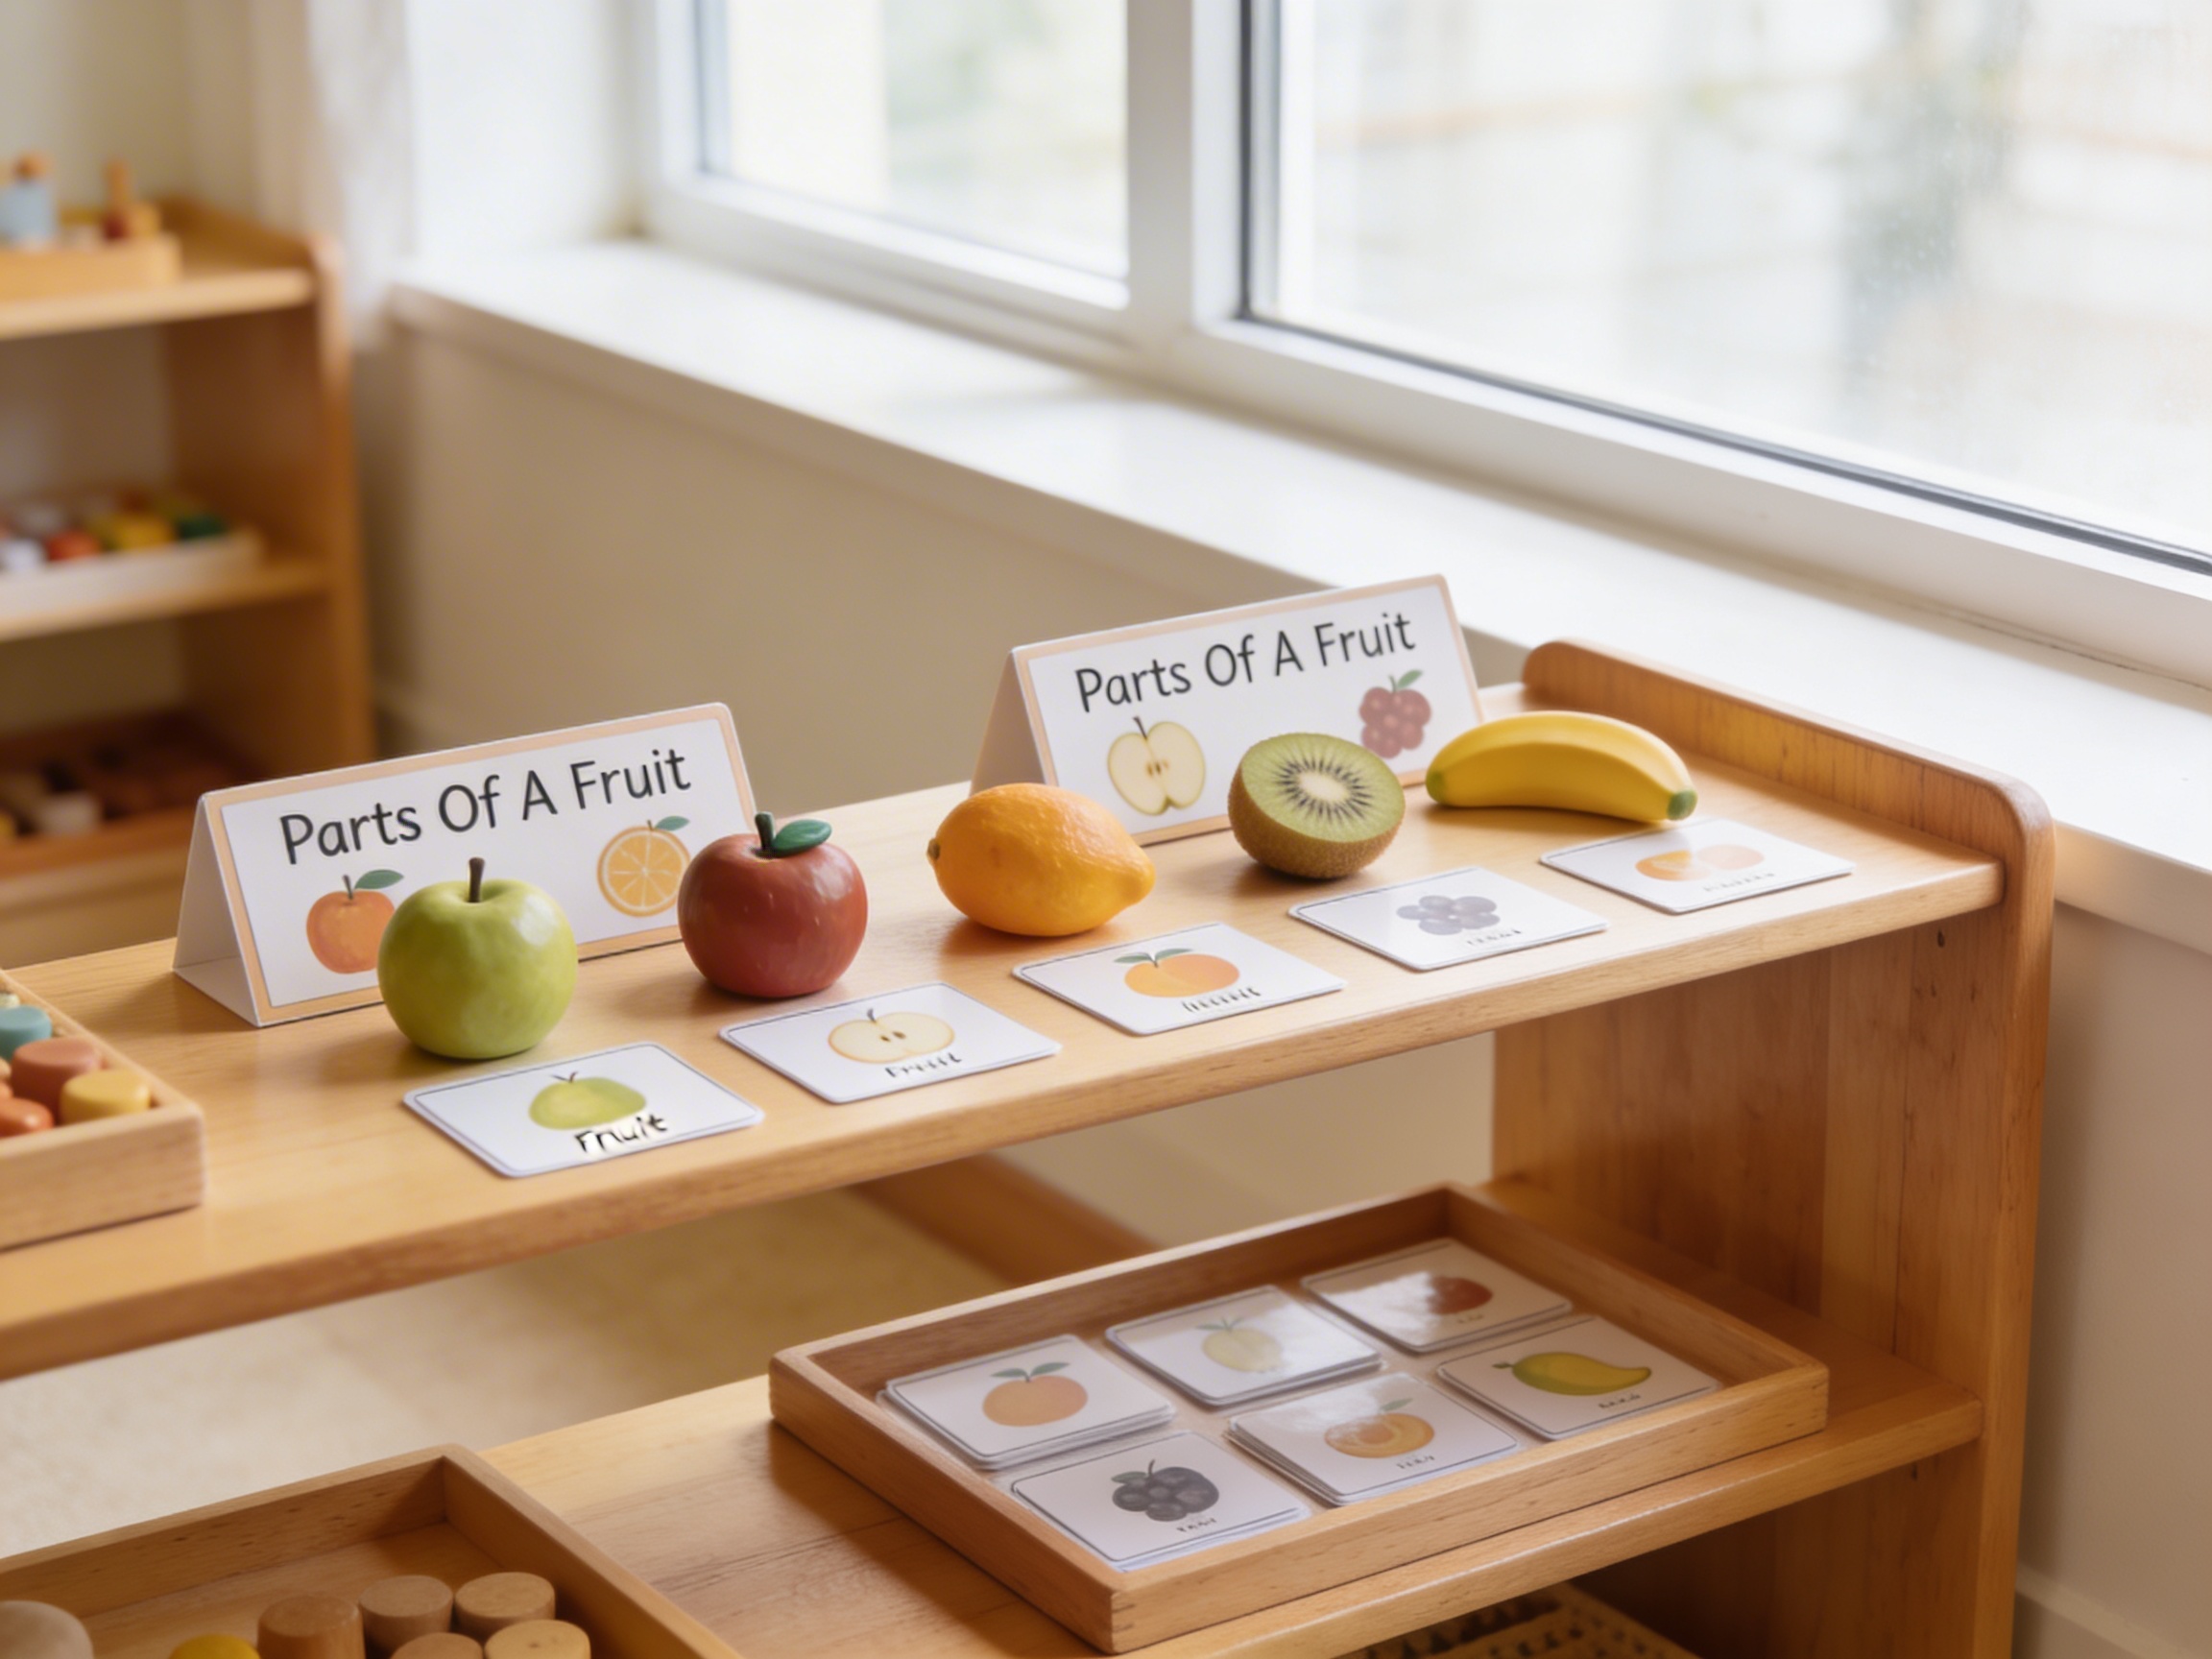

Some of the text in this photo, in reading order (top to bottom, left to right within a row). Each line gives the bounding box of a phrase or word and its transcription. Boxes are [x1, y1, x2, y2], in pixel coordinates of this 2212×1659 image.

[1074, 612, 1416, 712] Parts Of A Fruit
[279, 748, 692, 865] Parts Of A Fruit
